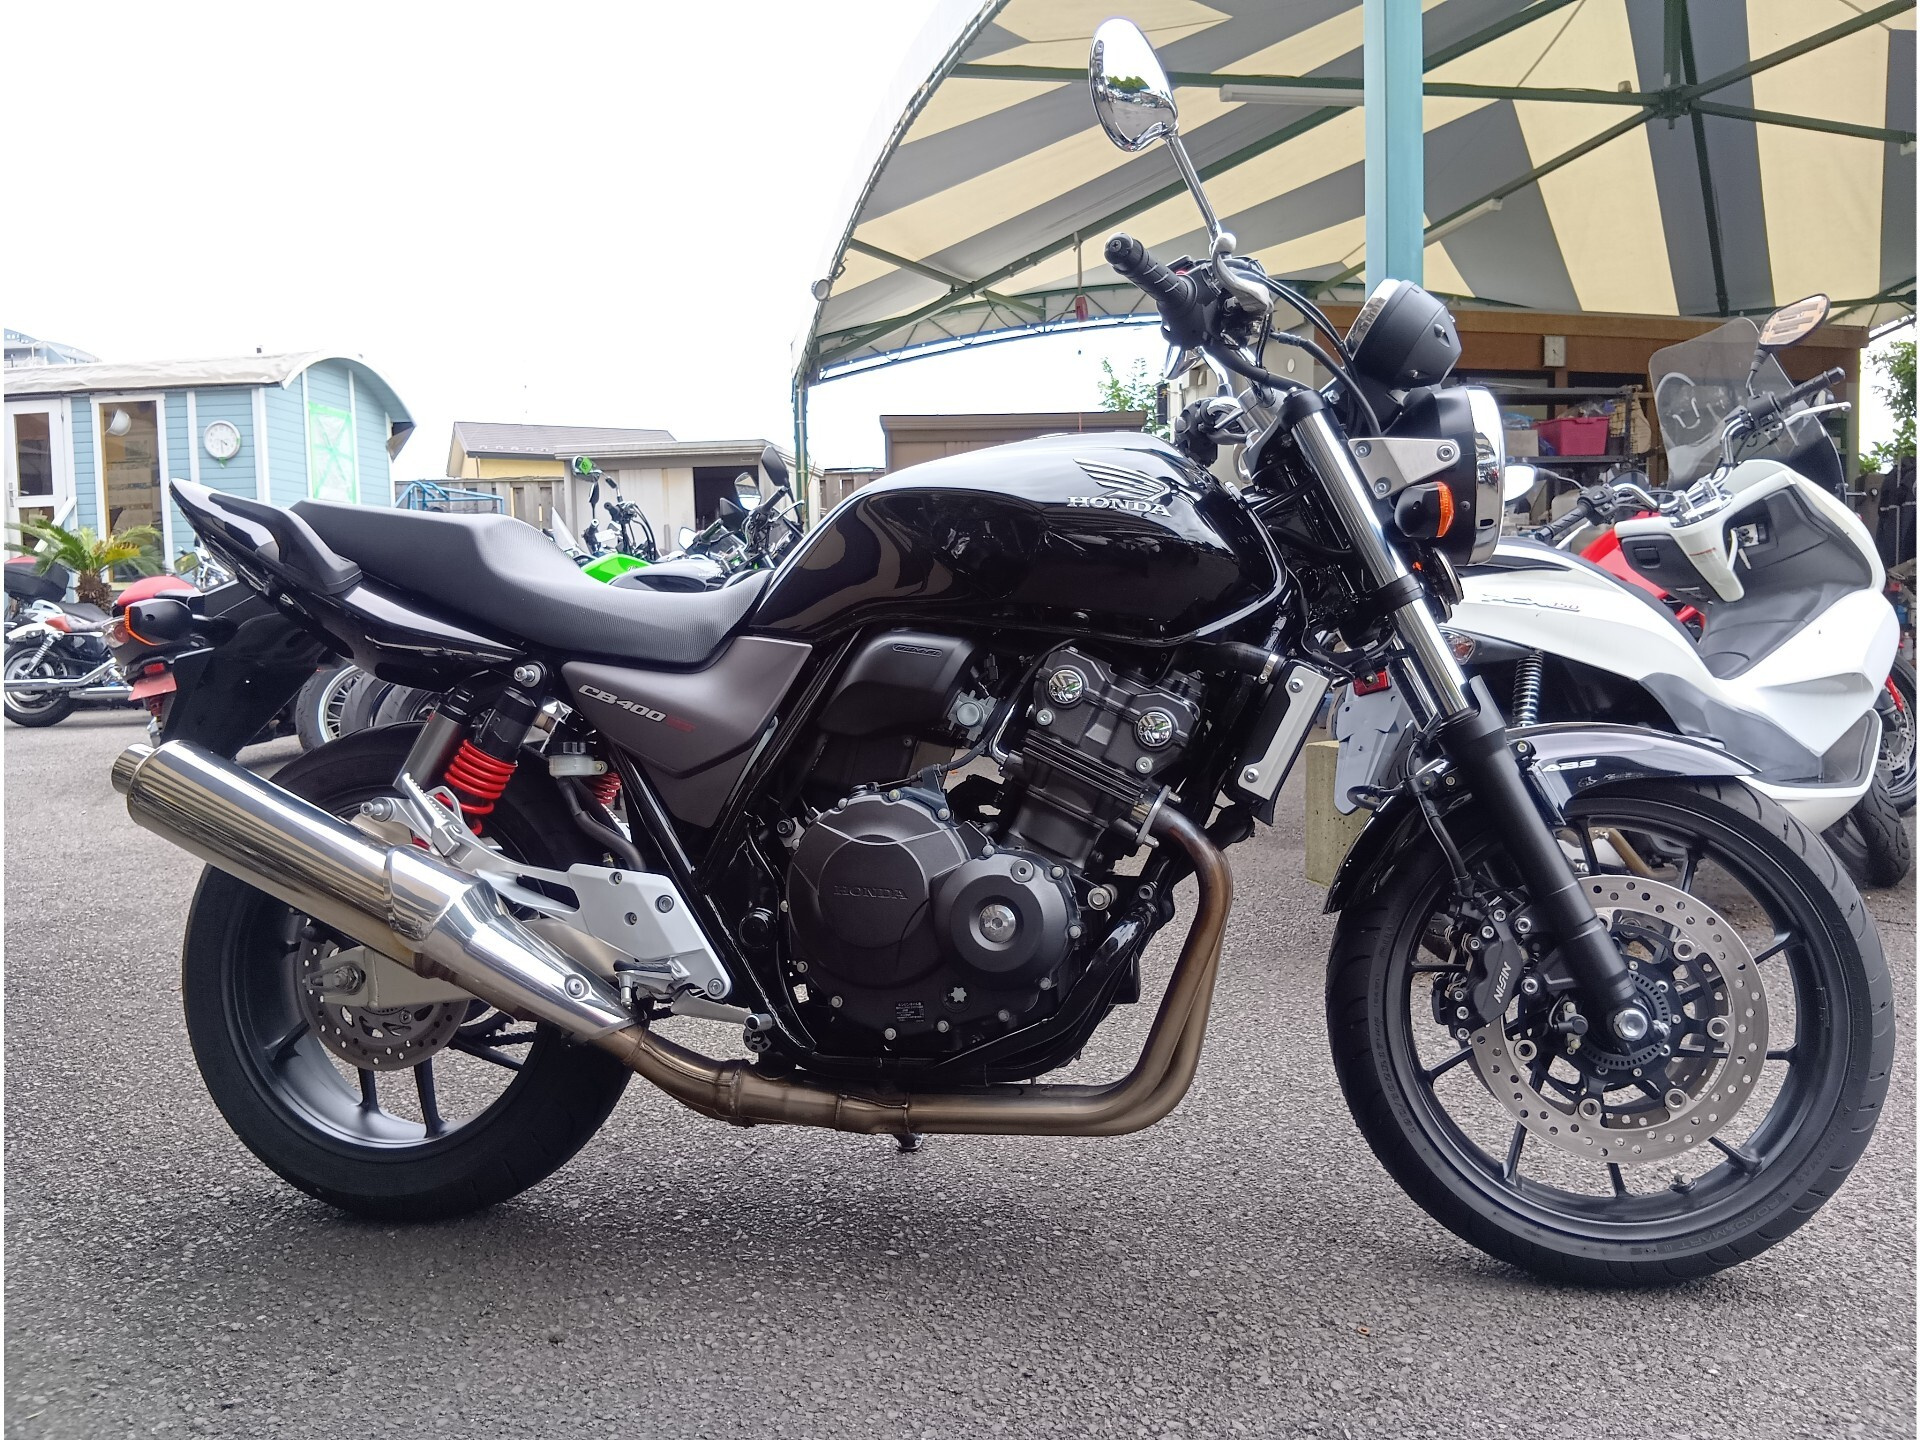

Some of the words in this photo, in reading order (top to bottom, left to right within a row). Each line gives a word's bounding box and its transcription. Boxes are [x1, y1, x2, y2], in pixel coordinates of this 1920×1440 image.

[1067, 496, 1172, 517] HONDA
[578, 684, 667, 722] CB400
[833, 885, 908, 900] HONDA
